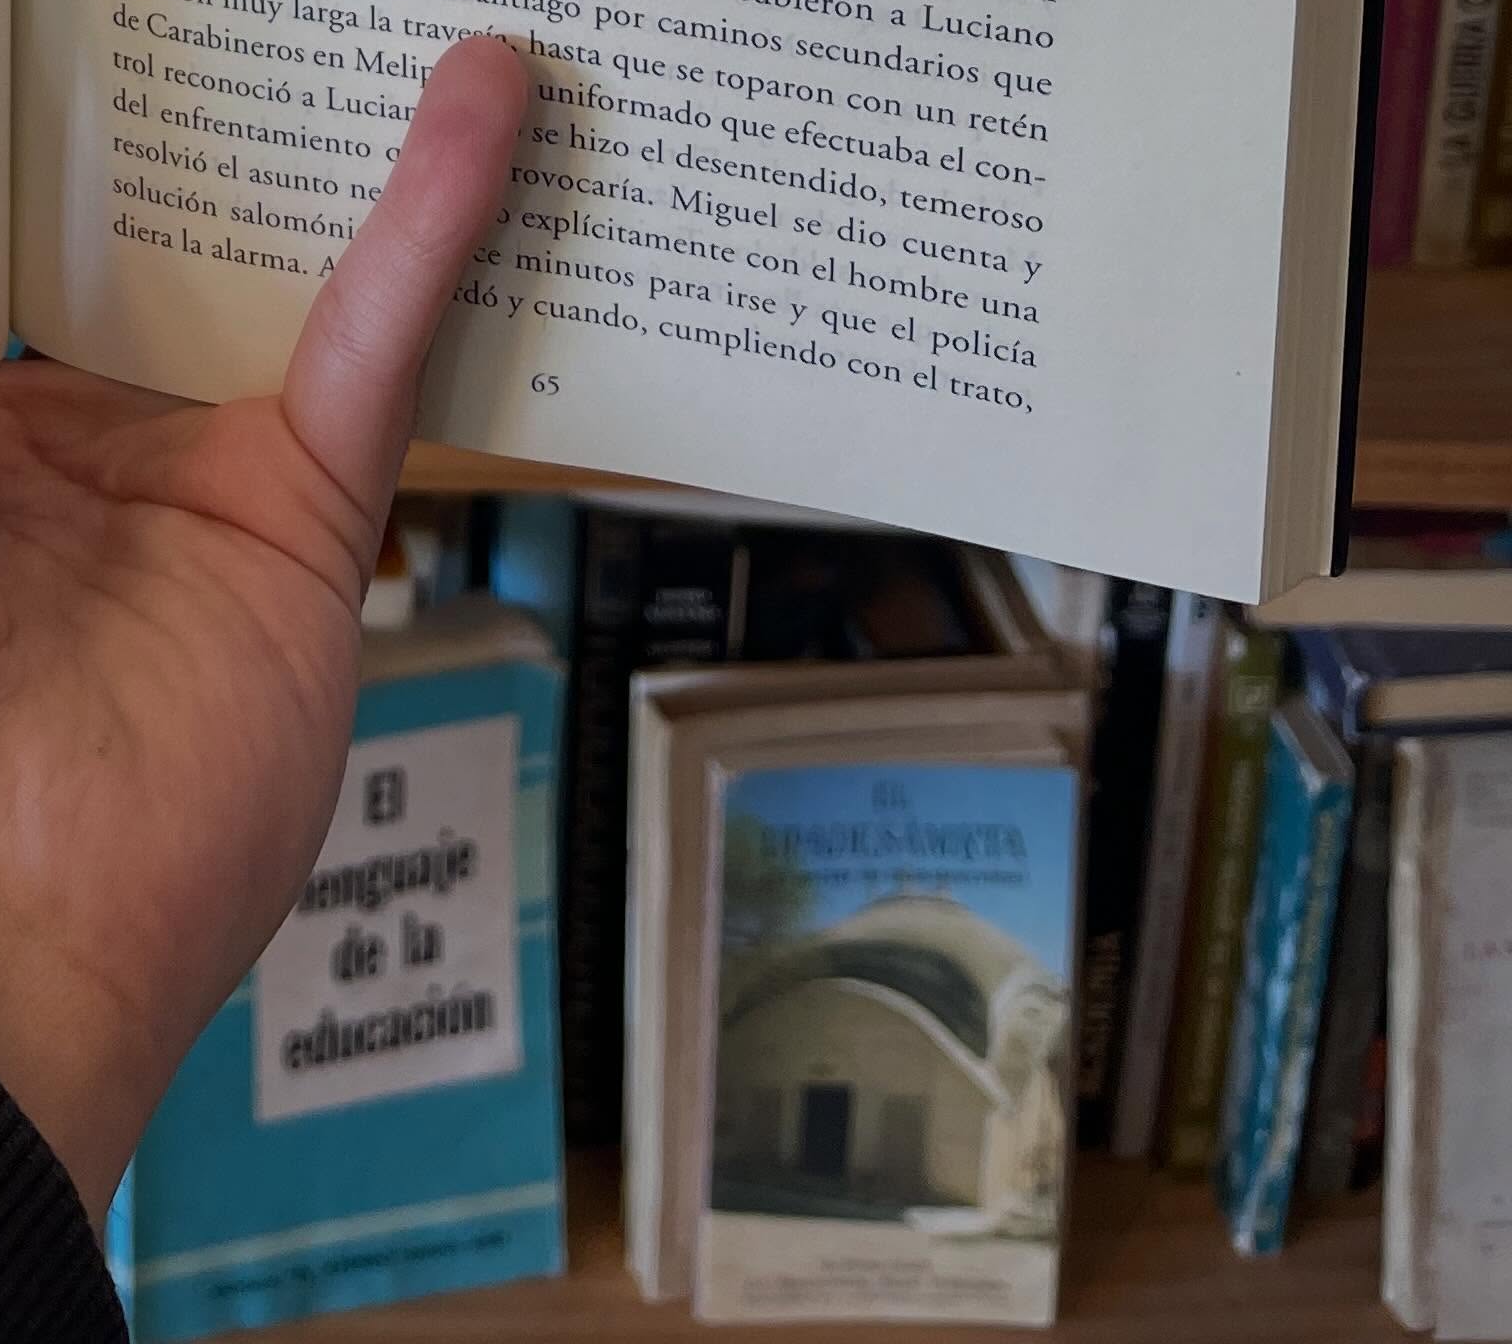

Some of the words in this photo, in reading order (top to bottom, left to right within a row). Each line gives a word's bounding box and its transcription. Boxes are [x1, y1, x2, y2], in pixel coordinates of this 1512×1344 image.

[506, 294, 526, 320] y
[532, 299, 649, 338] cuando,
[657, 320, 838, 370] cumpliendo
[846, 357, 902, 384] con
[911, 363, 938, 392] el
[949, 376, 1034, 415] trato,
[529, 372, 562, 397] 65
[363, 767, 407, 826] El
[294, 826, 478, 913] enguaje
[331, 925, 385, 984] de
[402, 912, 443, 968] la
[282, 985, 496, 1073] educación
